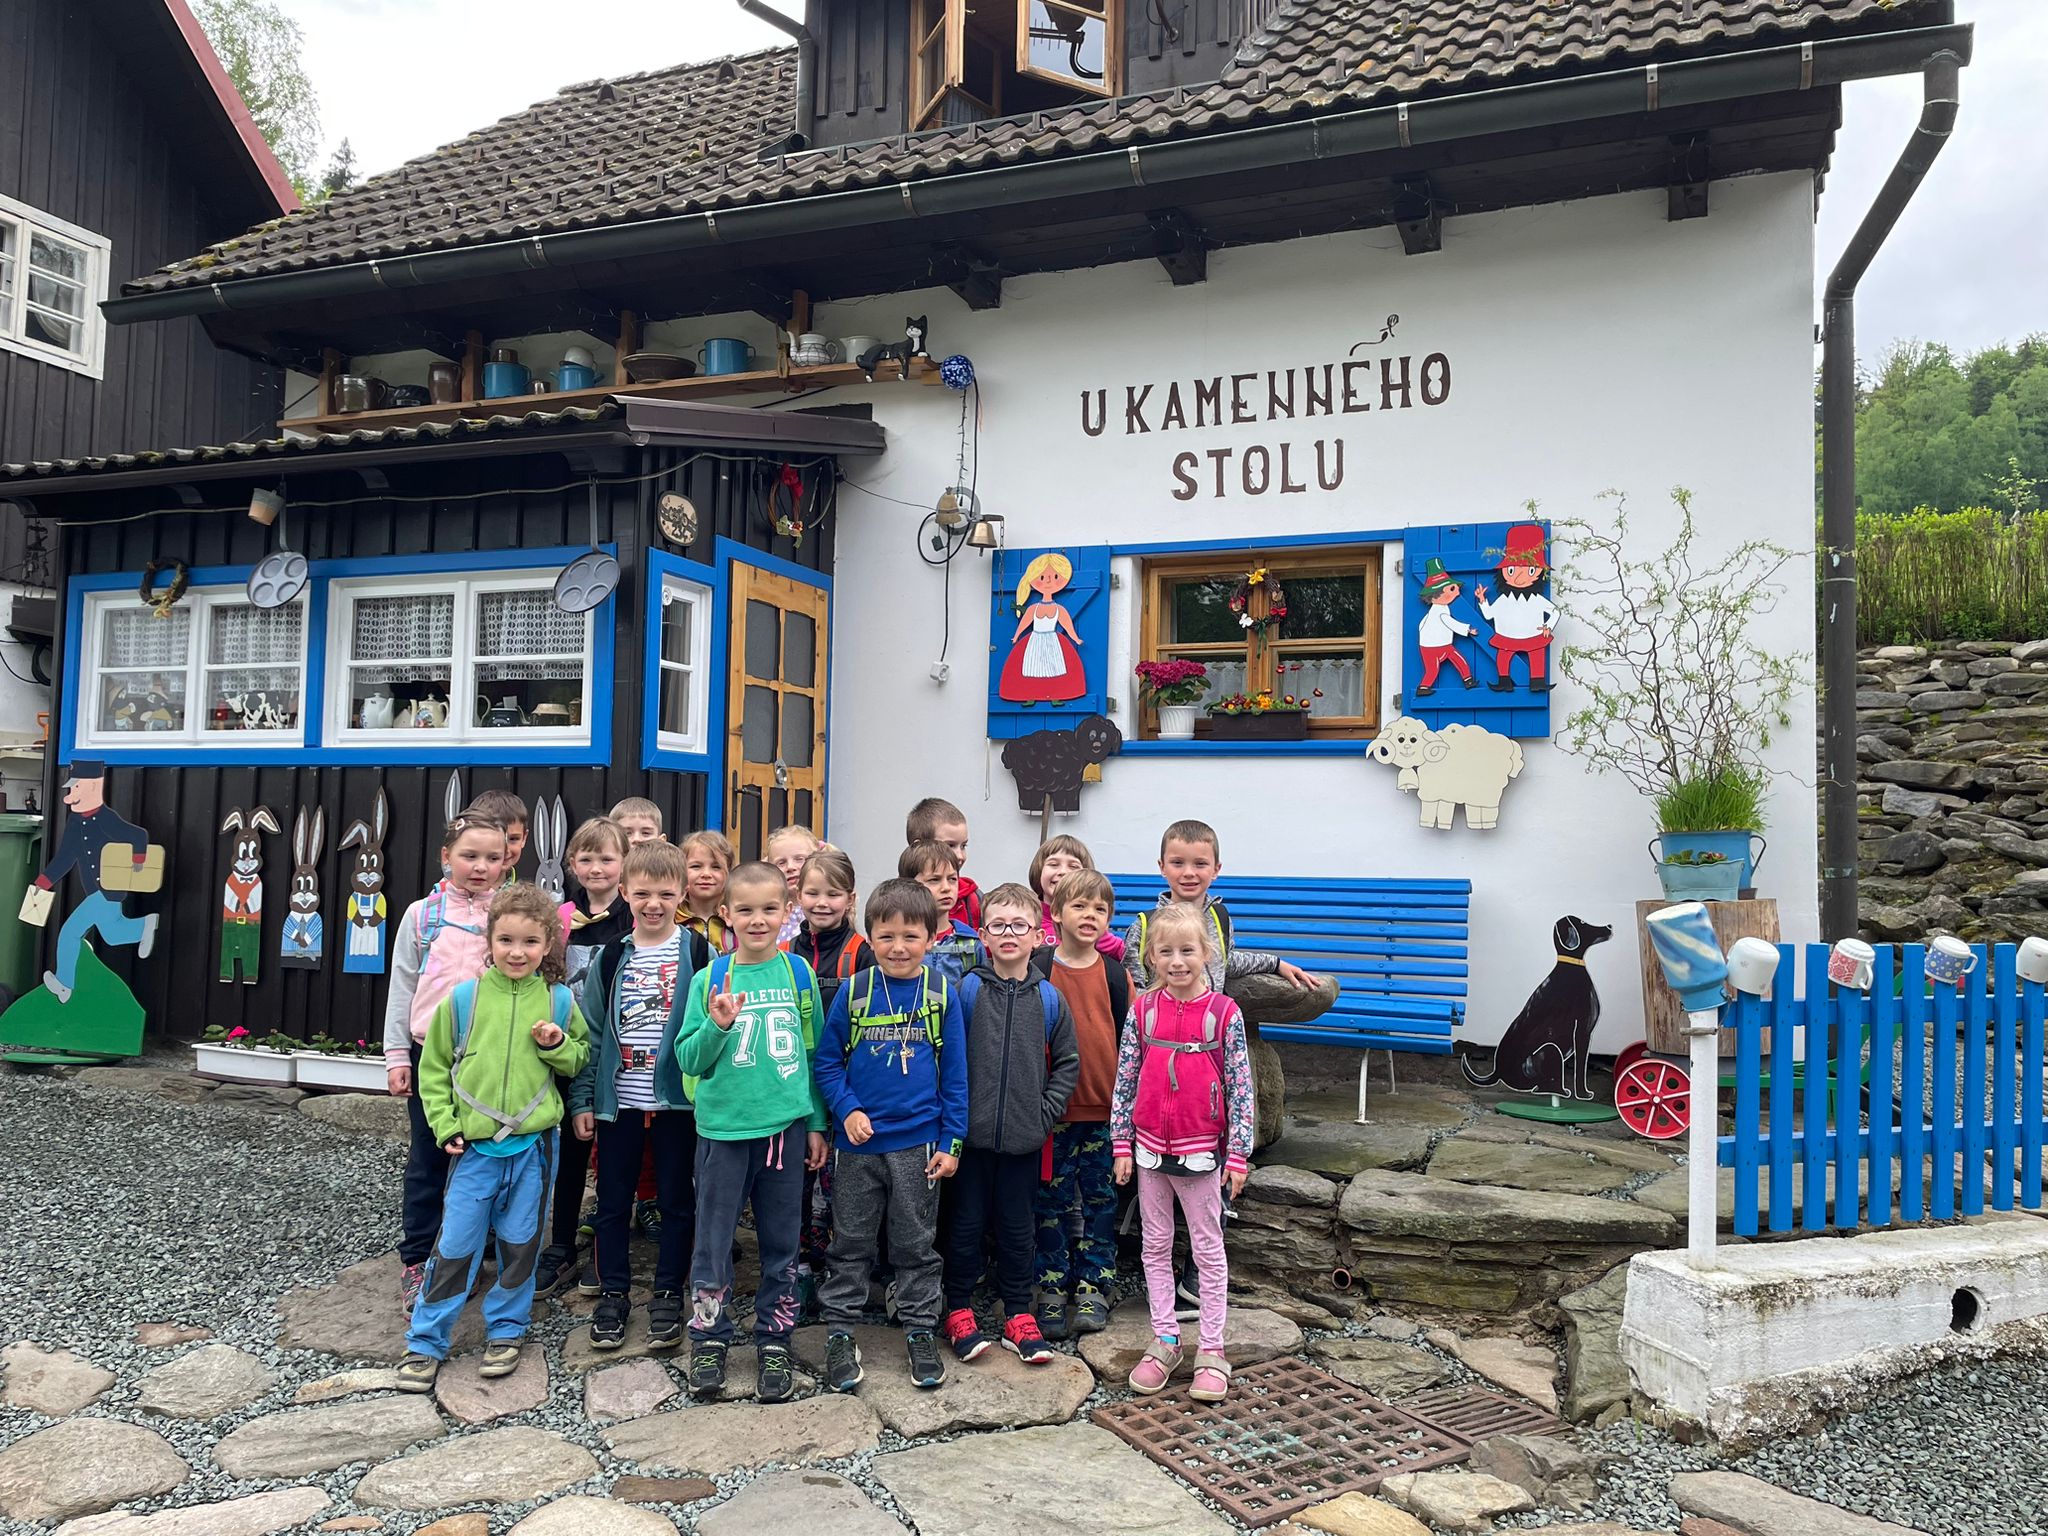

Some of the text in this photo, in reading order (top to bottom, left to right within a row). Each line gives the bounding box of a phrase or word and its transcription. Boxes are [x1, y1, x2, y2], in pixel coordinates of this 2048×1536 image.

[1080, 388, 1107, 437] U
[1170, 438, 1345, 501] STOLU
[731, 1008, 800, 1068] 76
[862, 1026, 927, 1041] MINECRAF
